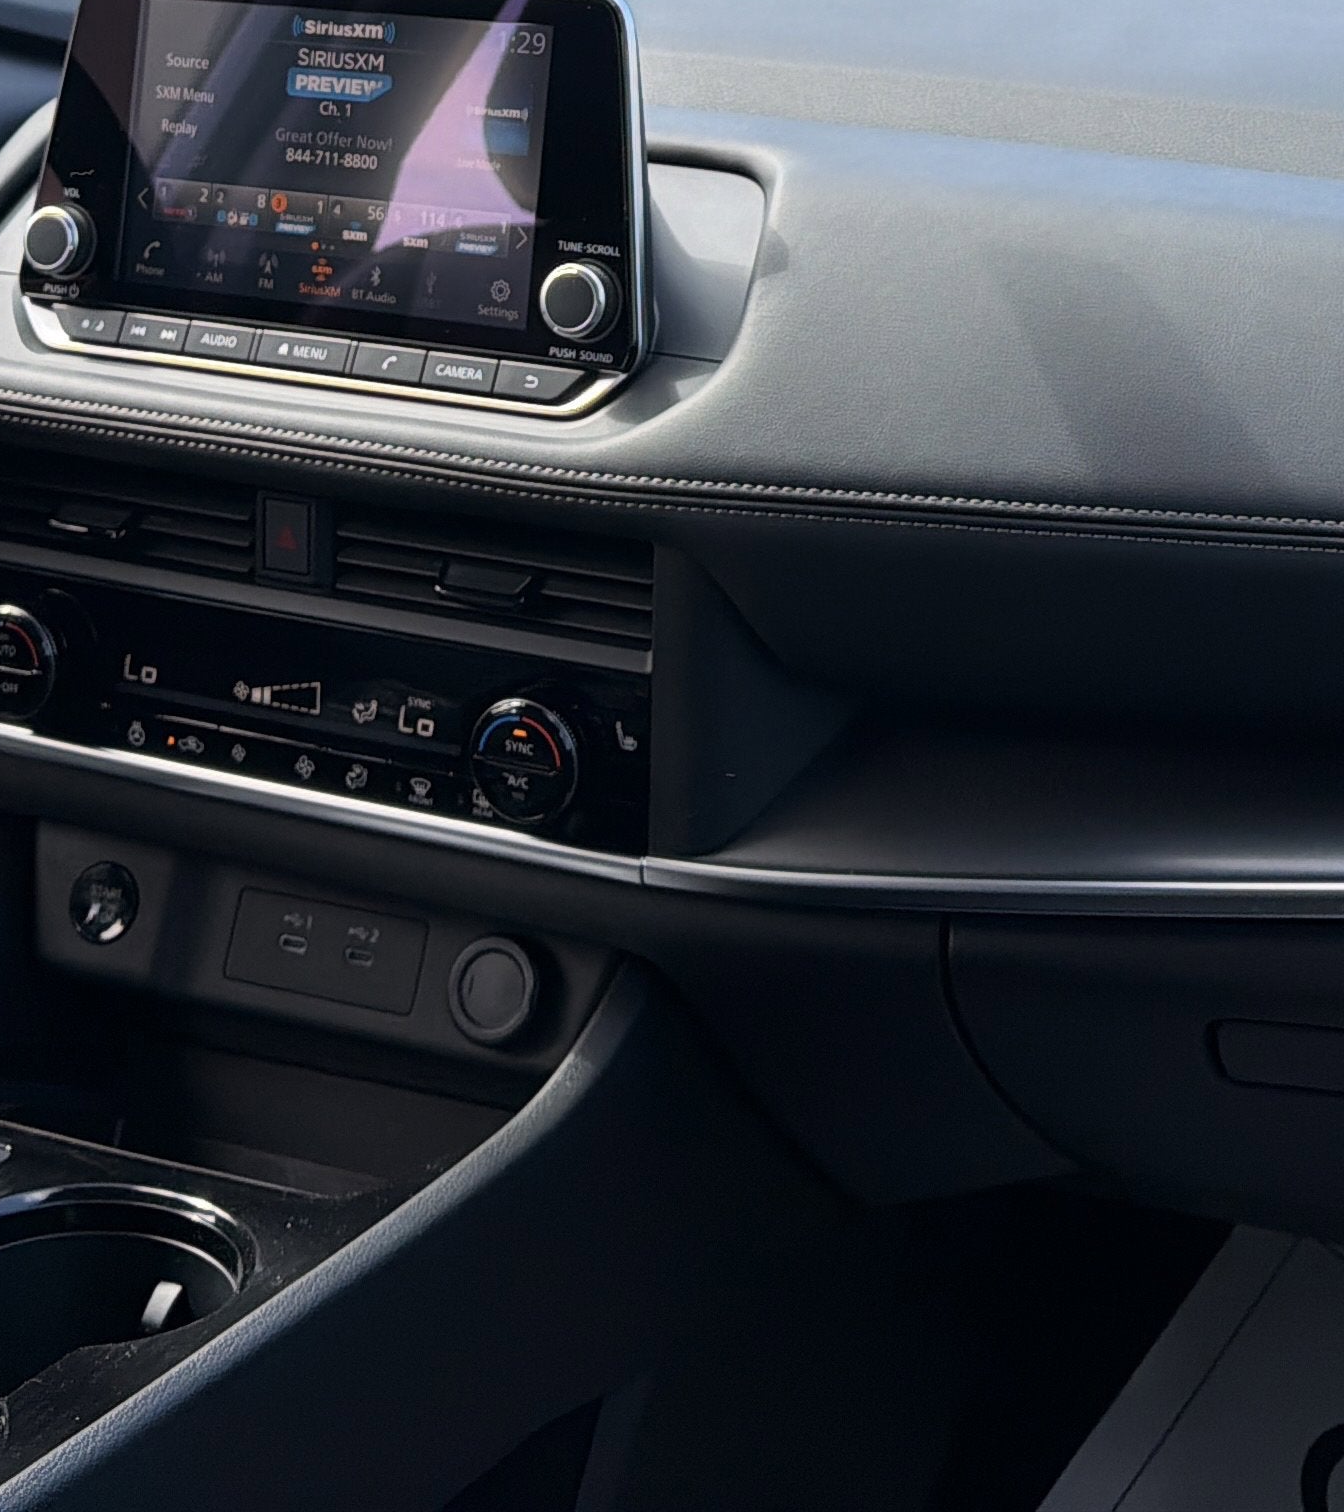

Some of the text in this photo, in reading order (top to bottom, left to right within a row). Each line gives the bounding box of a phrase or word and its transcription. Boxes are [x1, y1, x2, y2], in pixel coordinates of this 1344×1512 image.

[165, 52, 210, 70] Source
[297, 48, 385, 72] SIRIUSXM
[295, 73, 383, 96] PREVIEW
[156, 84, 215, 104] SXM Menu
[319, 101, 353, 118] Ch. 1
[161, 118, 198, 138] Replay
[275, 127, 393, 152] Great Offer Now!
[285, 147, 379, 170] 844-711-8800
[64, 187, 80, 199] VOL
[200, 188, 209, 203] 2
[257, 193, 267, 209] 8
[367, 205, 385, 221] 56
[205, 272, 223, 283] AM
[258, 278, 274, 289] FM
[43, 282, 67, 295] PUSH
[298, 282, 342, 297] SiriusXM
[352, 288, 397, 304] BT Audio
[478, 304, 520, 321] Settings
[200, 332, 238, 348] AUDIO
[293, 344, 327, 360] MENU
[549, 346, 613, 364] PUSH SOUND
[435, 363, 483, 381] CAMERA
[408, 696, 432, 710] SYNC
[505, 739, 534, 756] SYNC
[508, 776, 529, 790] A/C
